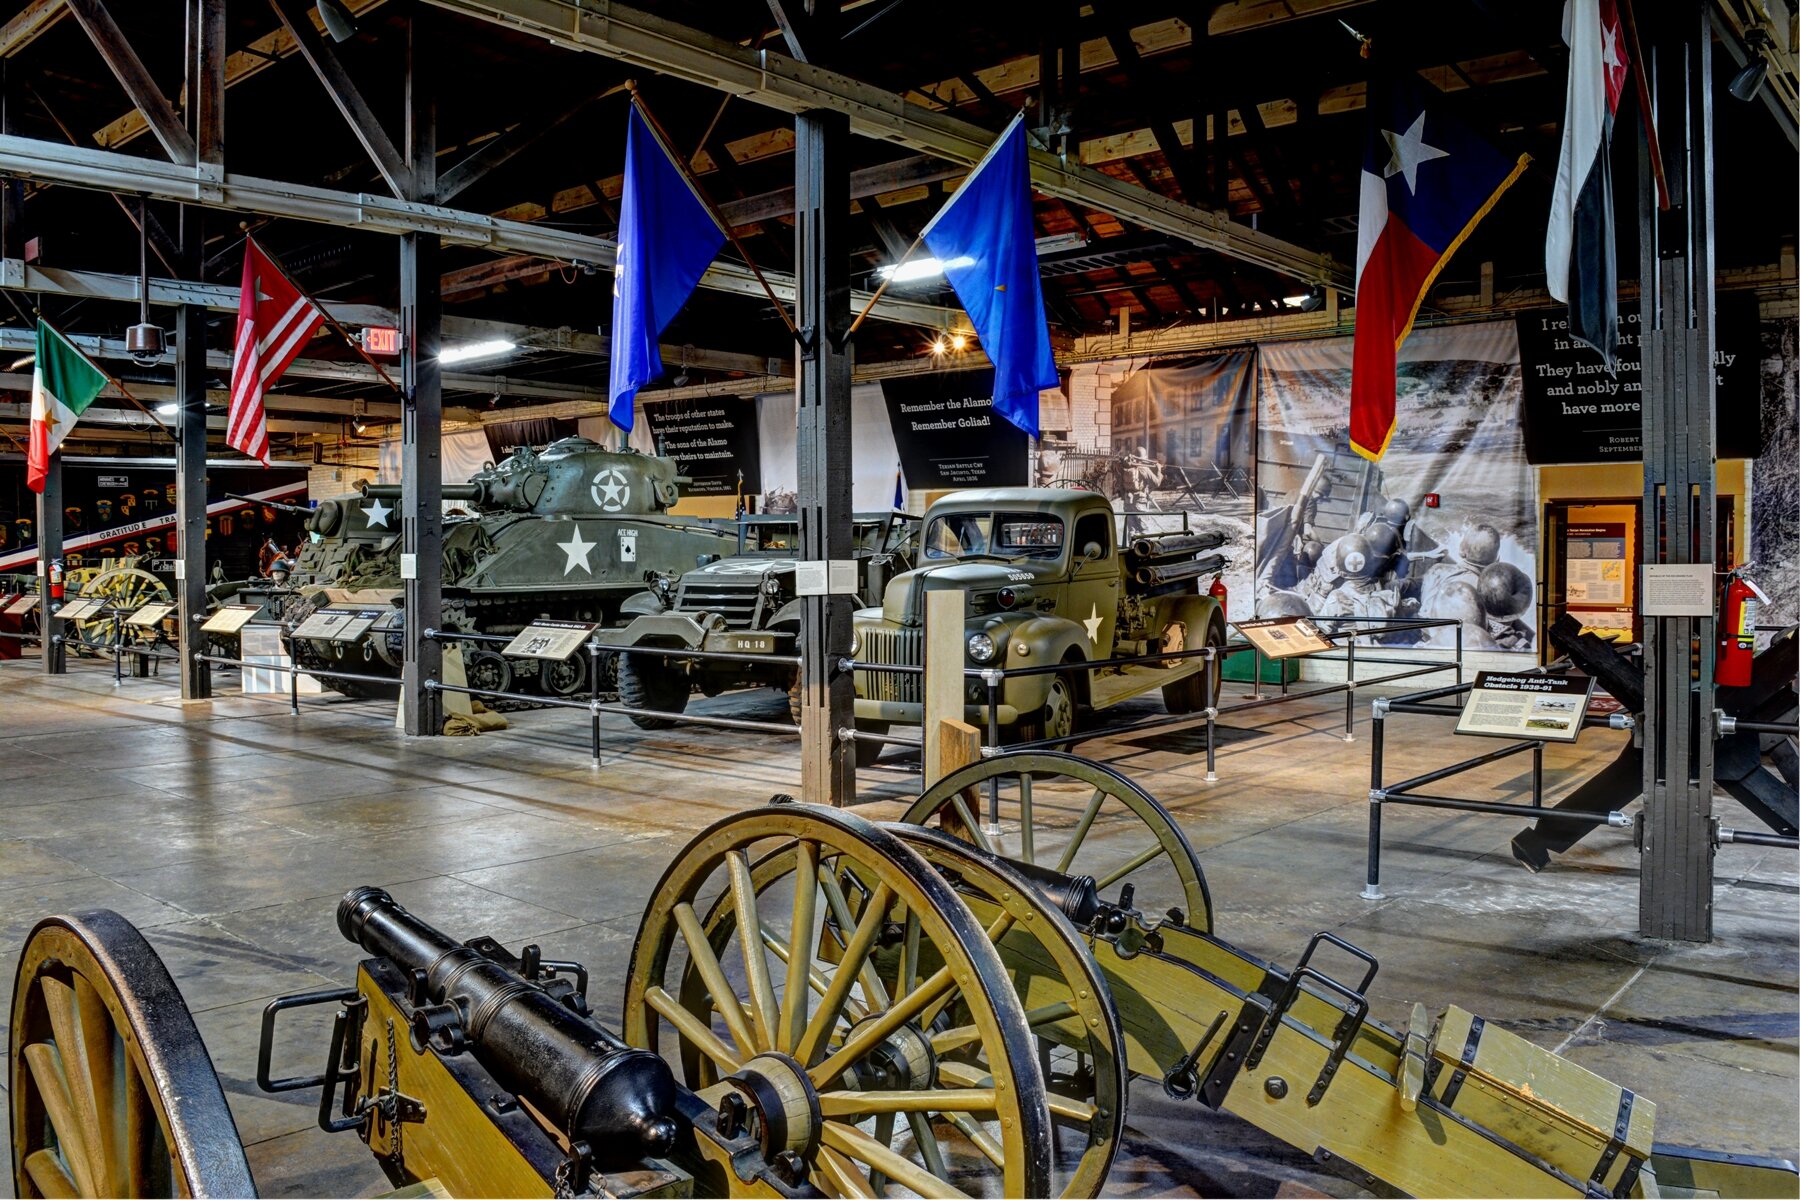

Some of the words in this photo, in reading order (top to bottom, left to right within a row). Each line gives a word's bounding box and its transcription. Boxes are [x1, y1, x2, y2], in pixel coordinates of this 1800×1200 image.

[1542, 318, 1548, 330] I
[370, 329, 395, 351] EXIT
[1554, 339, 1570, 350] in
[1536, 364, 1573, 378] They
[1616, 359, 1642, 372] fou
[1547, 382, 1574, 396] and
[1577, 380, 1619, 395] nobly
[900, 401, 945, 412] Remember
[946, 399, 961, 409] the
[1562, 402, 1597, 414] have
[1601, 402, 1640, 412] more
[654, 414, 665, 422] The
[666, 412, 683, 421] troops
[684, 410, 690, 418] of
[691, 410, 706, 418] other
[665, 425, 678, 433] their
[679, 423, 708, 433] reputation
[716, 420, 734, 429] make.
[911, 419, 956, 430] Remember
[958, 416, 990, 427] Goliad!
[665, 441, 676, 449] The
[690, 439, 696, 447] of
[697, 439, 707, 447] the
[708, 438, 727, 446] Alamo
[680, 452, 697, 460] theirs
[705, 450, 733, 458] maintain.
[100, 522, 147, 539] GRATITUDE
[160, 516, 176, 524] TRA
[738, 640, 750, 648] HQ
[1486, 676, 1526, 684] Hedgehog
